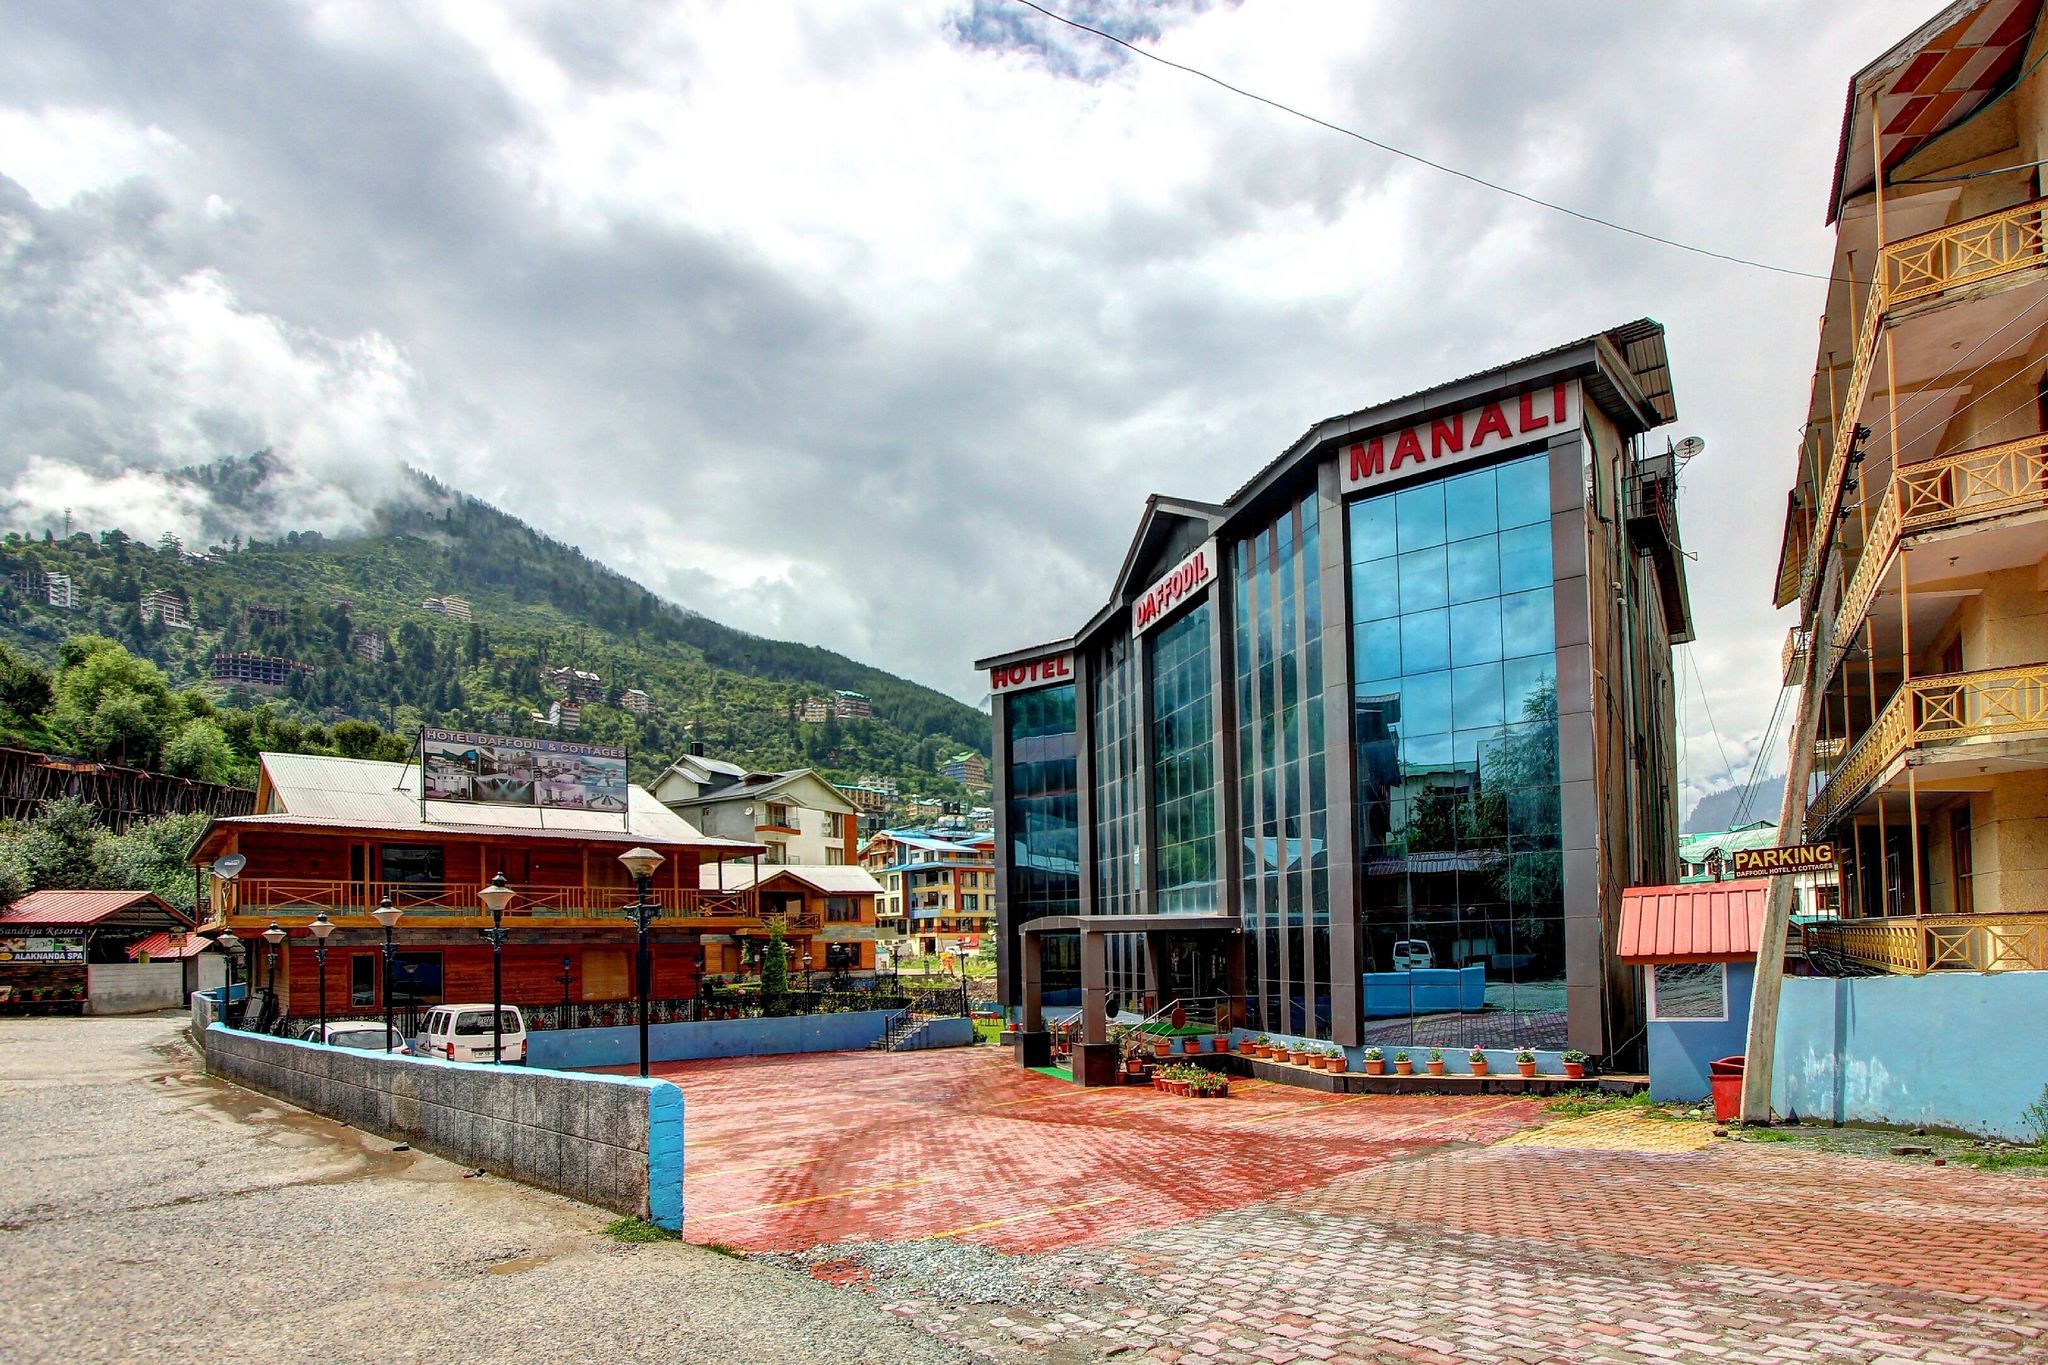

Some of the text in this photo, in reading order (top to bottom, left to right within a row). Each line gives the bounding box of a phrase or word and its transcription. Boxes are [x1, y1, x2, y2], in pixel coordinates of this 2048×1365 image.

[1350, 382, 1566, 481] MANALI
[1136, 552, 1208, 628] DAFFODIL
[992, 655, 1070, 689] HOTEL
[426, 730, 626, 758] HOTEL DAFFODIL & COTTAGES
[1735, 844, 1832, 869] PARKING
[1736, 868, 1769, 878] DAFFODIL
[1769, 866, 1791, 875] HOTEL
[1797, 862, 1833, 872] COTTAGES
[0, 925, 84, 937] Sandhya Resorts
[14, 952, 84, 961] ALAKNANDA SPA
